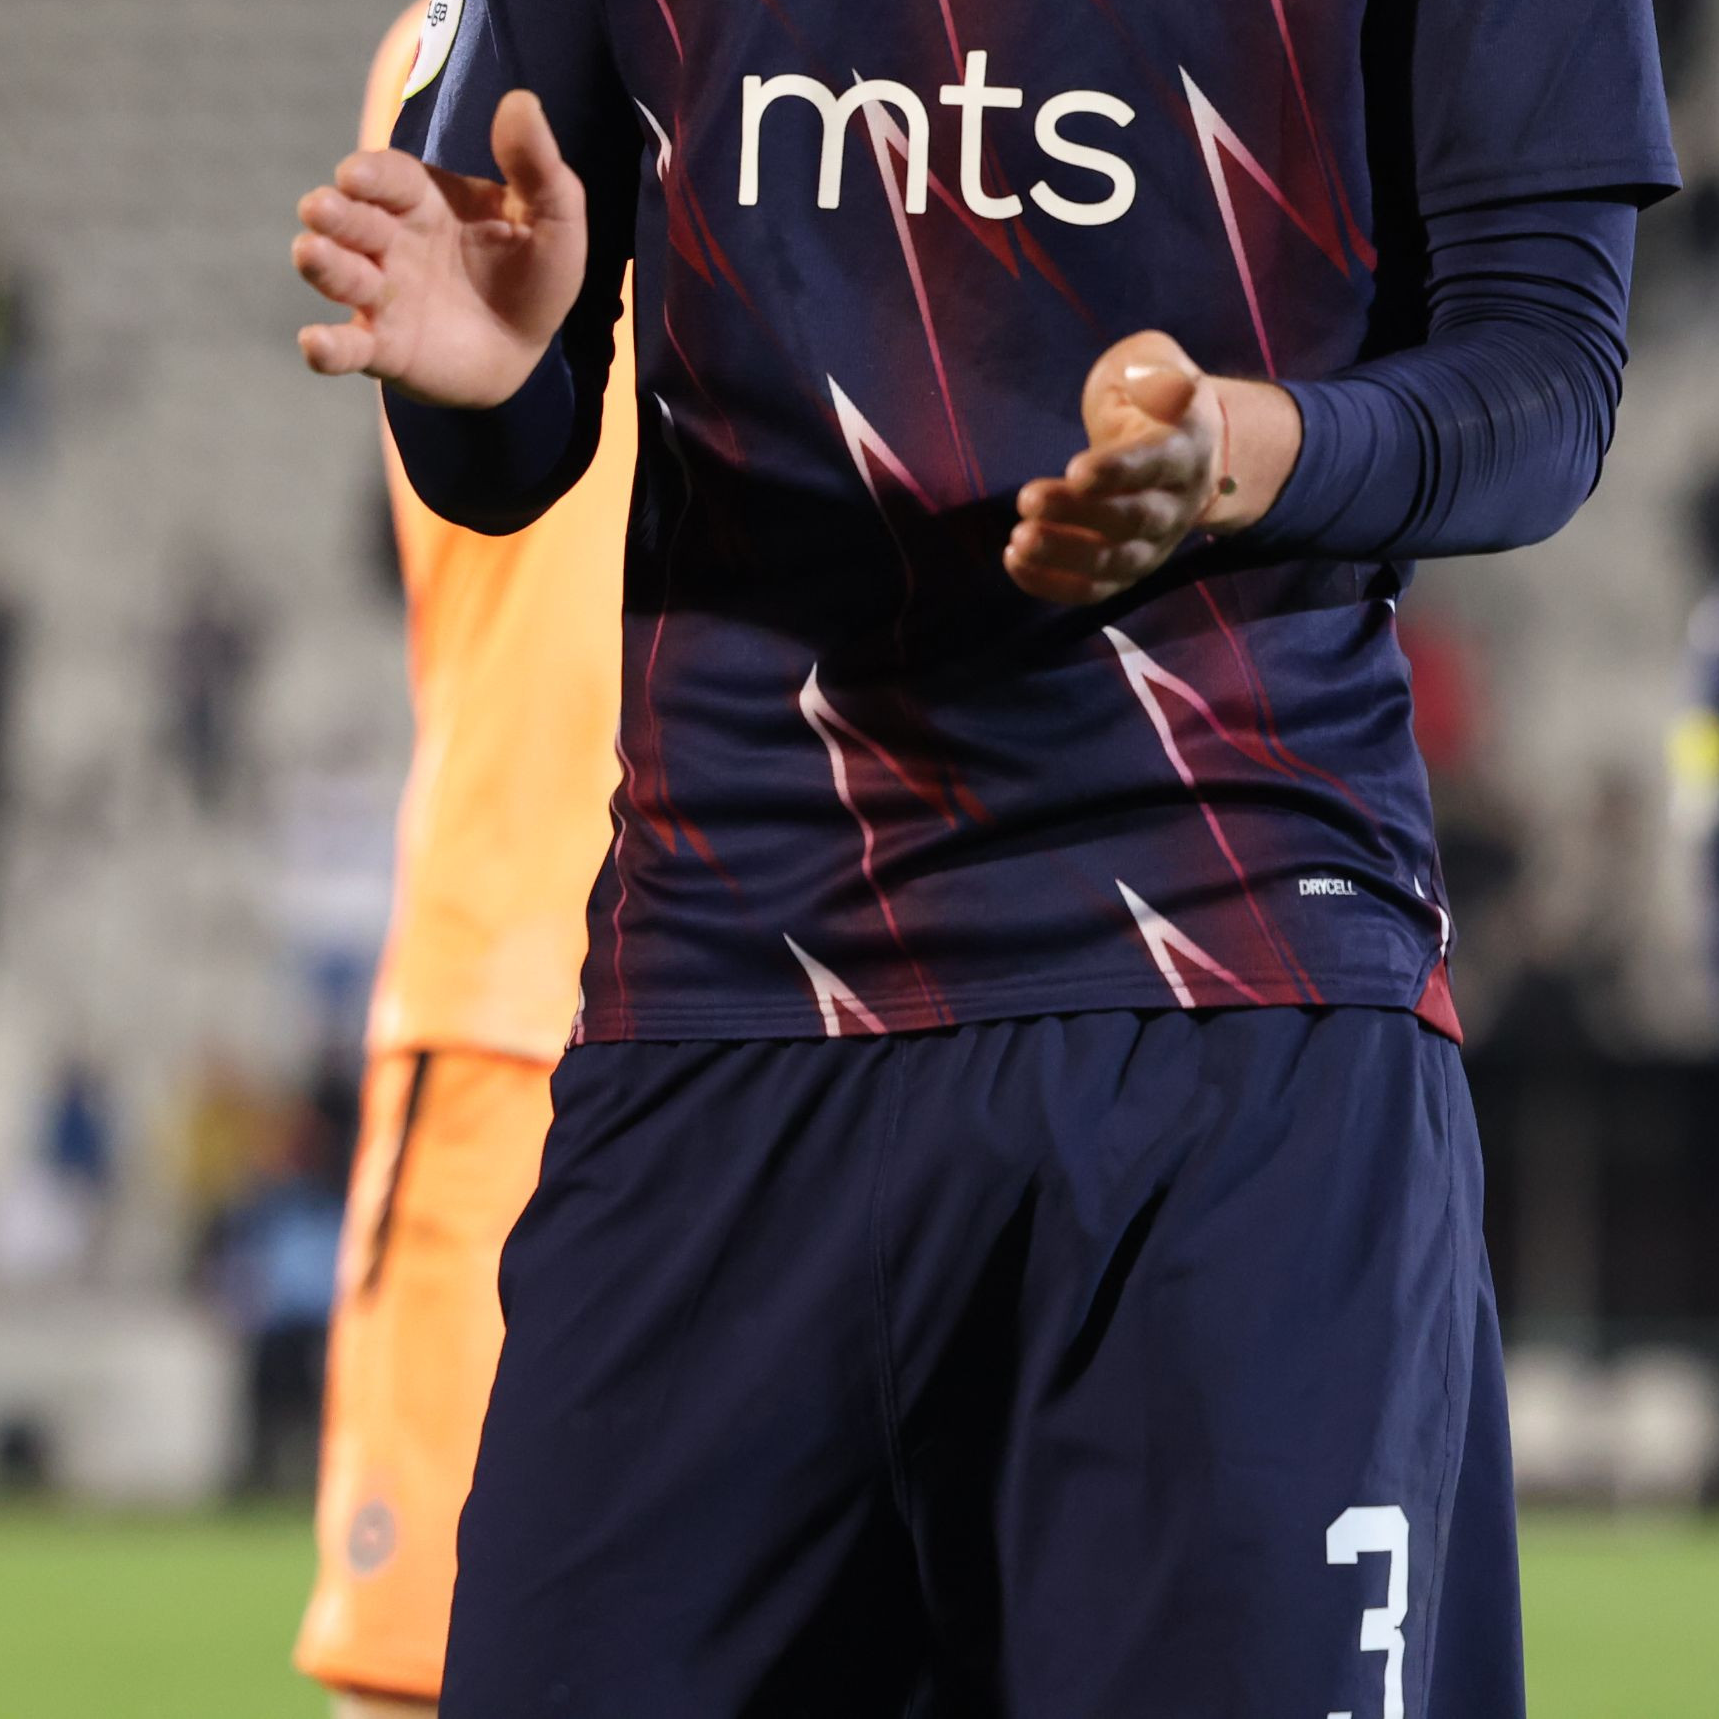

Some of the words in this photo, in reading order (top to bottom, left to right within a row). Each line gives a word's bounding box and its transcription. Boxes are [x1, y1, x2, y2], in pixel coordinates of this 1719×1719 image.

[737, 49, 1137, 226] mts
[1298, 878, 1358, 897] DRYCELL
[1325, 1504, 1410, 1719] 3
